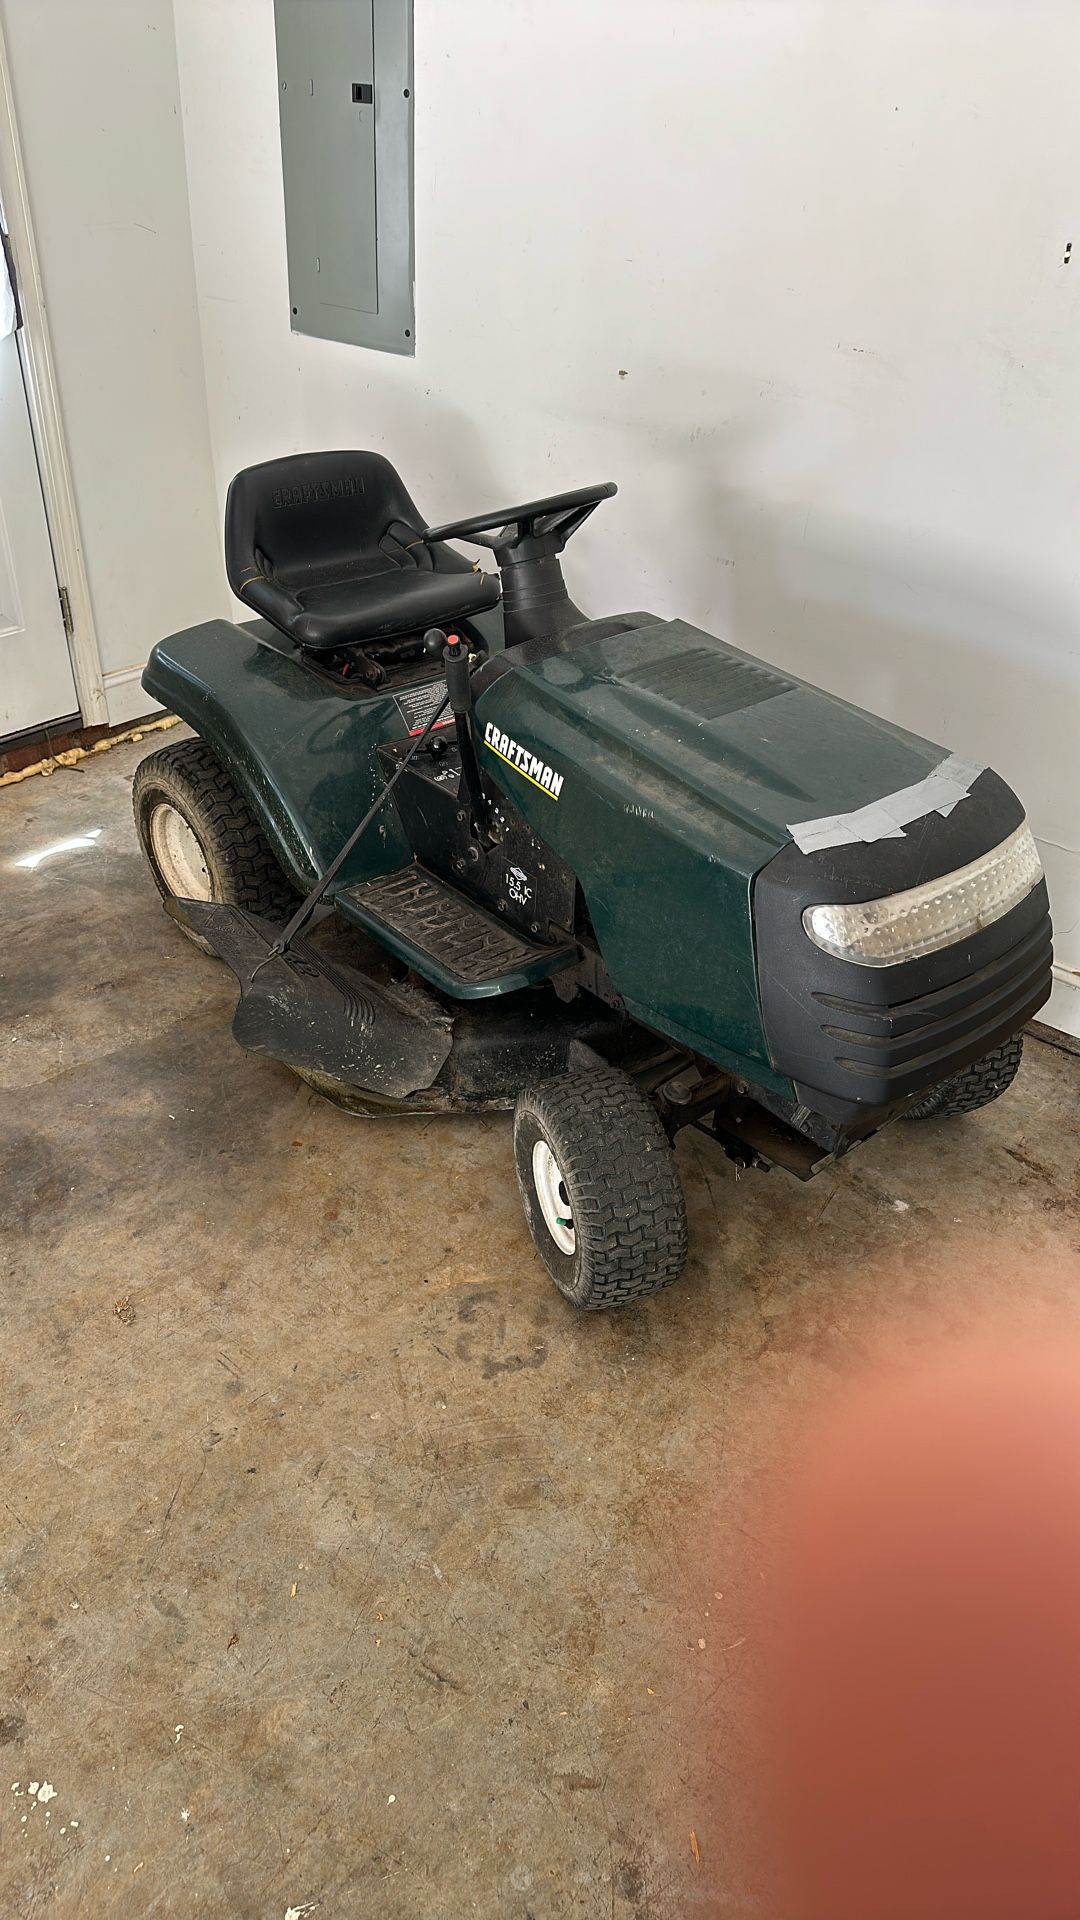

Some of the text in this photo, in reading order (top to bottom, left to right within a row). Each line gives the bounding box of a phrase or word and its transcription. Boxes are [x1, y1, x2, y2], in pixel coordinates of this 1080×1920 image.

[484, 721, 565, 797] CRAFTSMAN
[505, 873, 521, 891] 15.5
[508, 887, 528, 906] OHV
